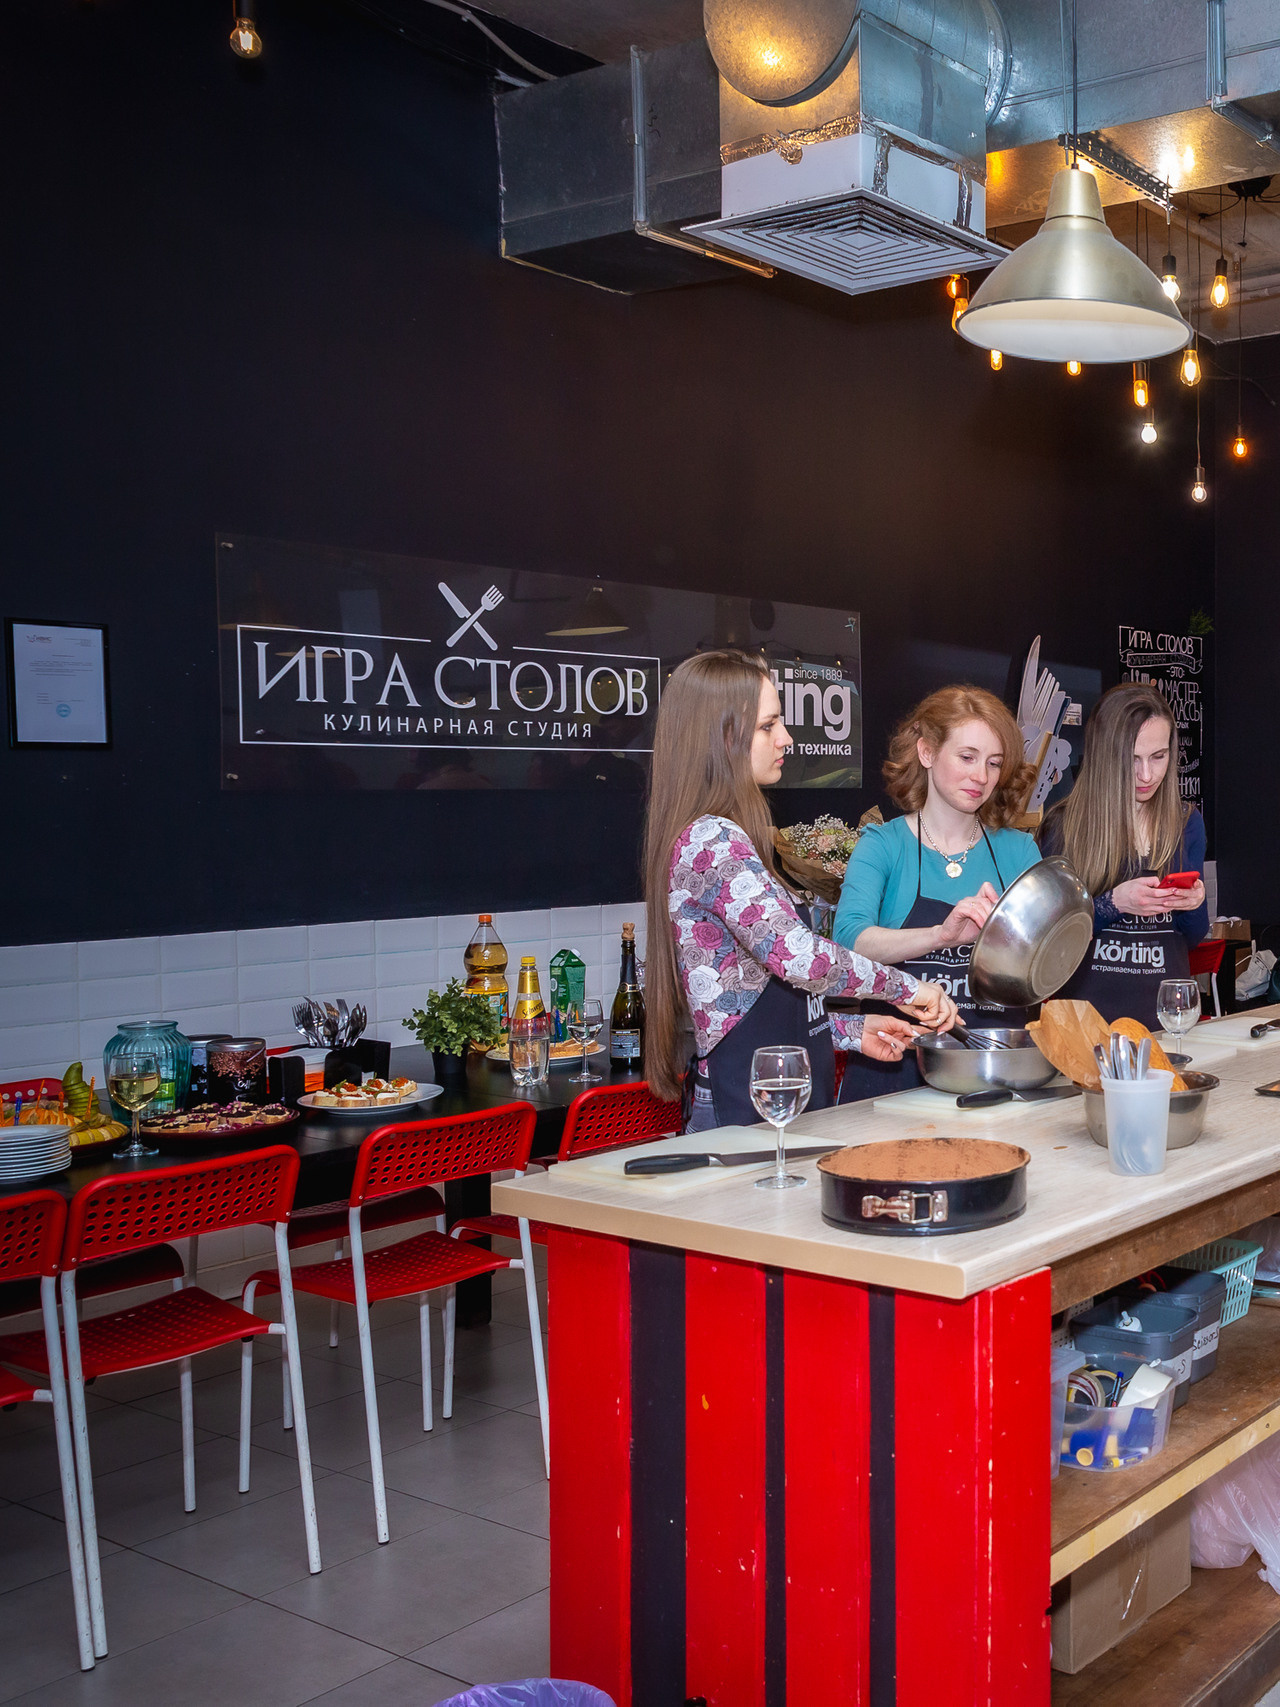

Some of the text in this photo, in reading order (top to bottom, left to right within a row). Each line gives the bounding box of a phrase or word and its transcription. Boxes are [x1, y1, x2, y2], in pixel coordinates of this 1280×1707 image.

[1128, 629, 1153, 649] ИГРА
[253, 641, 648, 717] ИГРА СТОЛОВ
[794, 667, 843, 681] since 1889
[324, 713, 592, 740] КУЛИНАРНАЯ СТУДИЯ
[798, 744, 852, 756] техника
[925, 954, 969, 963] КУЛИНАРНА
[1093, 939, 1165, 967] körting
[1091, 964, 1166, 975] встраиваемая техника
